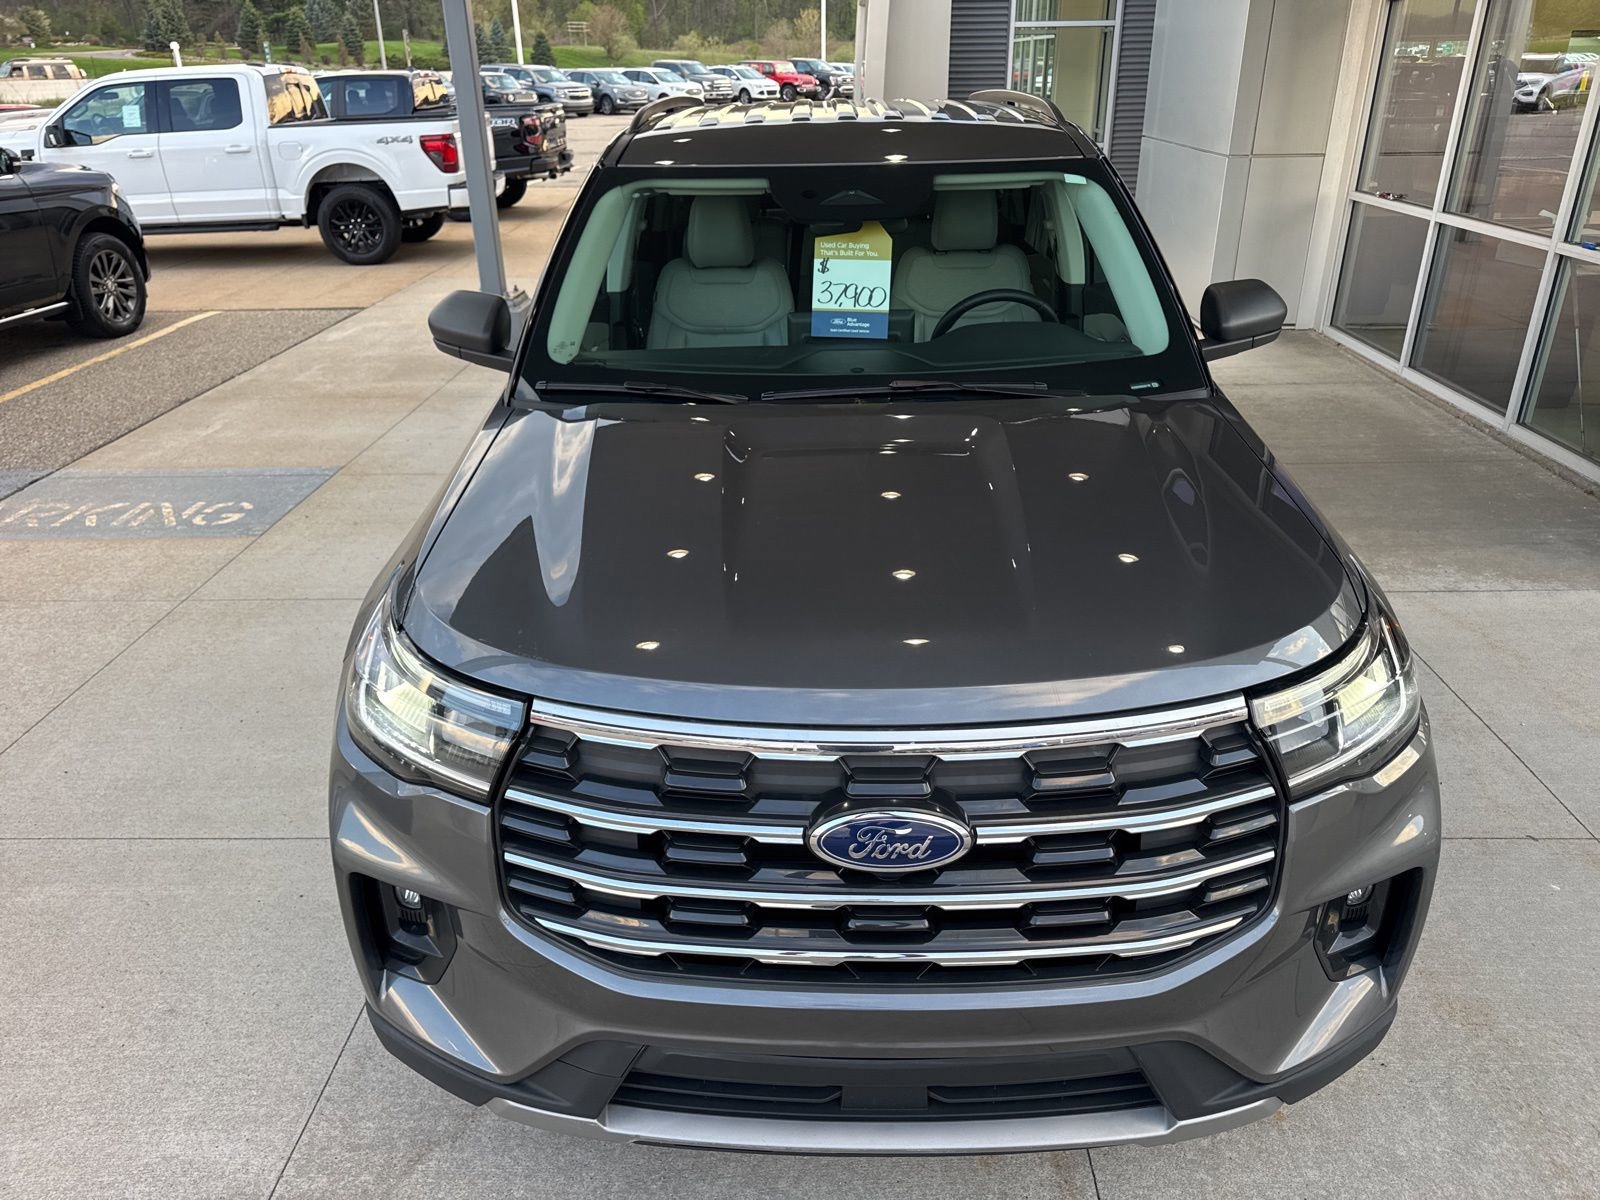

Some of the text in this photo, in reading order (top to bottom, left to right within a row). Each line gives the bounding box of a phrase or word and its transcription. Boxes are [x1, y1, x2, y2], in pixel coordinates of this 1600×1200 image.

[817, 257, 830, 274] $
[817, 280, 887, 308] 37,900
[848, 825, 934, 860] Ford
